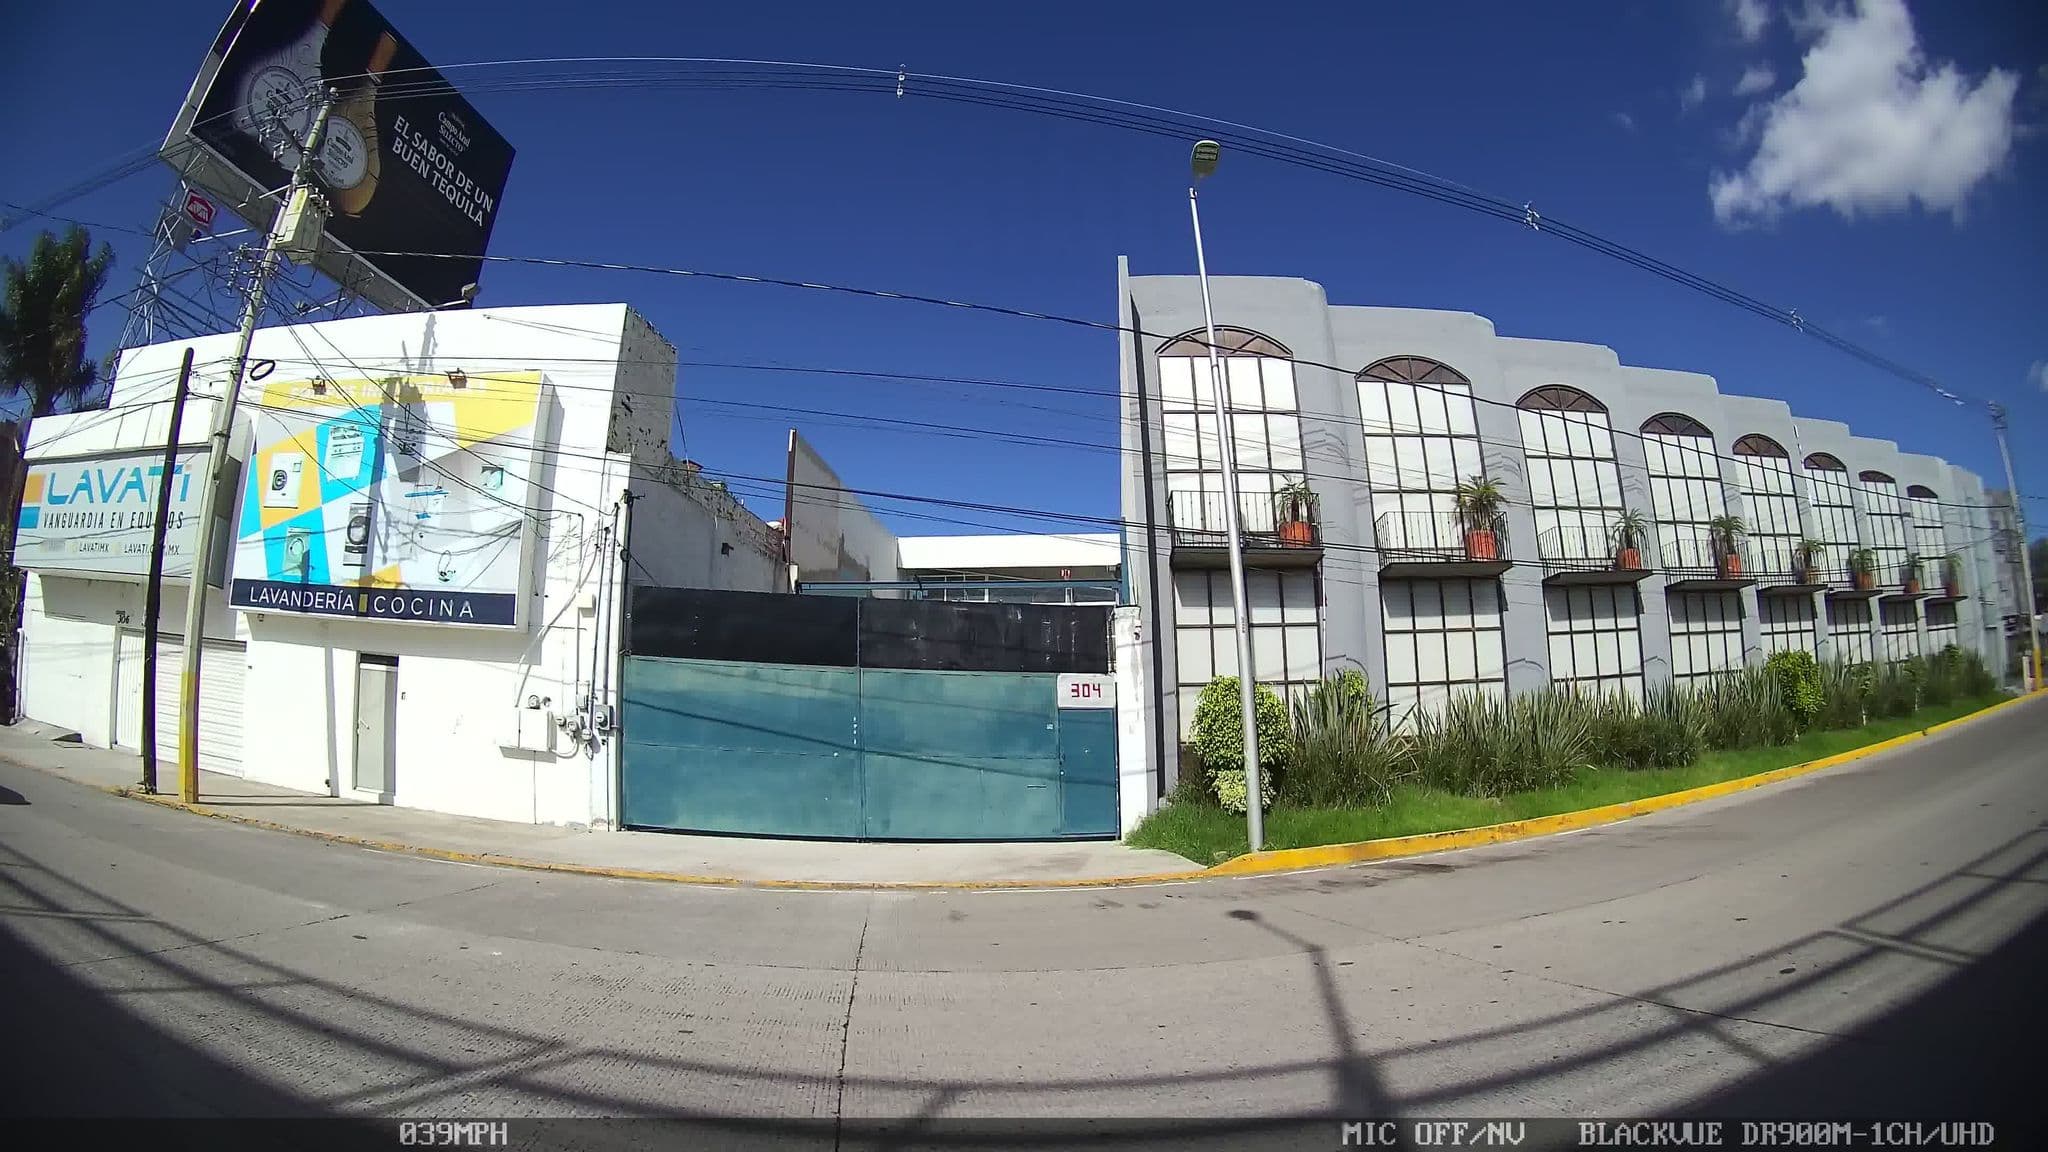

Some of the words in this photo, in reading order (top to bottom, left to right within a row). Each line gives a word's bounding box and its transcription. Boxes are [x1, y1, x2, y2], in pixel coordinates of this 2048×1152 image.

[393, 114, 410, 140] EL
[411, 131, 455, 179] SABOR
[455, 170, 474, 196] DE
[474, 186, 494, 213] UN
[392, 136, 430, 179] BUEN
[431, 170, 483, 227] TEQUILA
[43, 511, 104, 529] VANGUARDIA
[111, 511, 125, 529] EN
[130, 511, 184, 529] EQUOS
[249, 586, 355, 612] LAVANDERÍA
[373, 595, 474, 618] COCINA
[1071, 683, 1101, 698] 304
